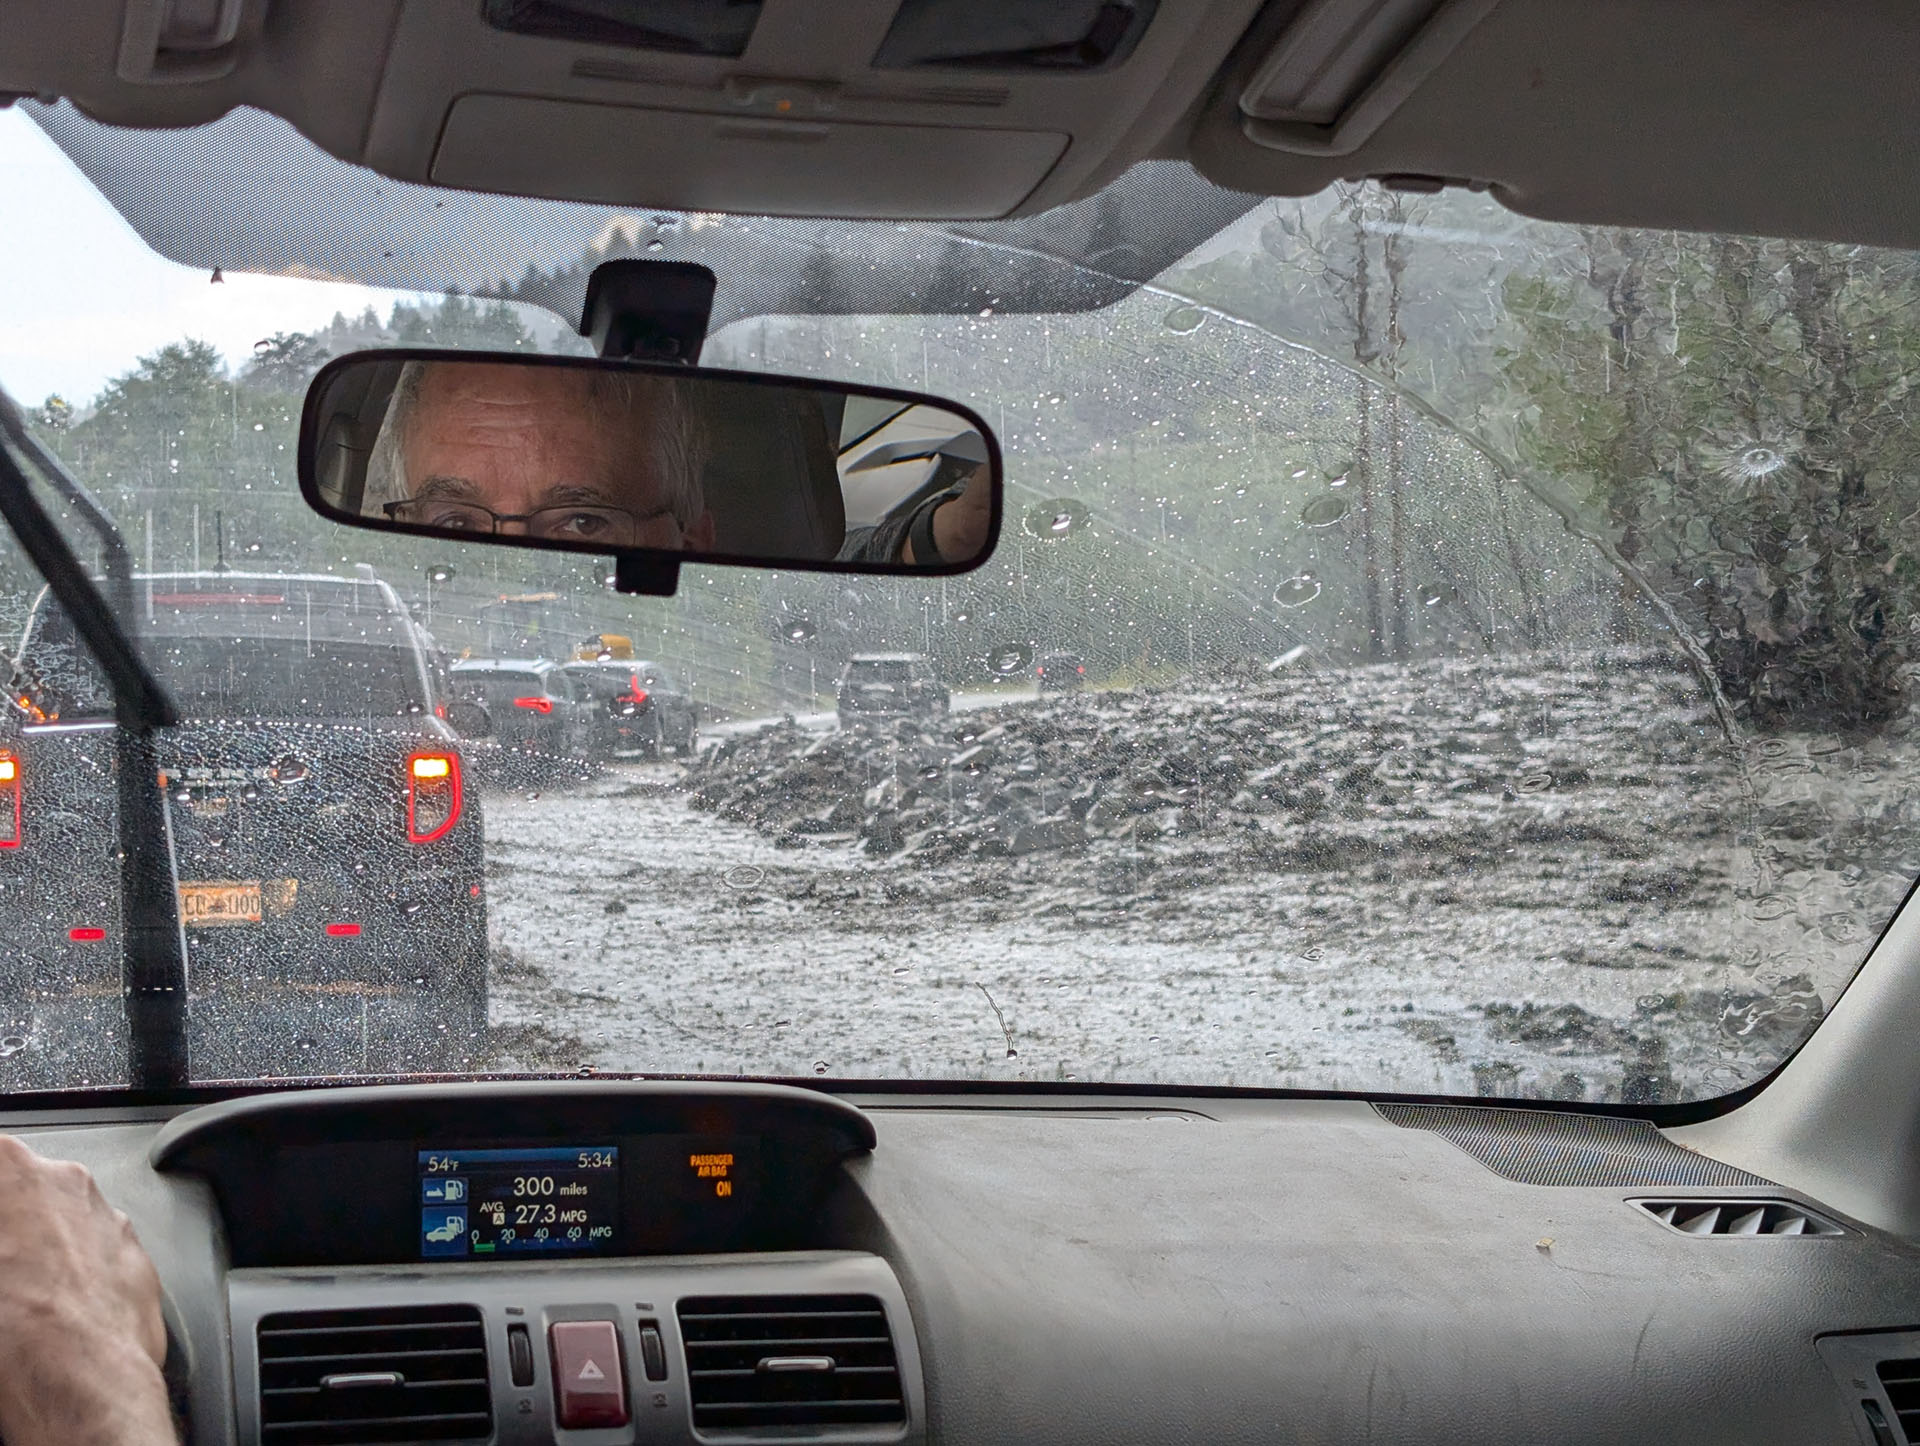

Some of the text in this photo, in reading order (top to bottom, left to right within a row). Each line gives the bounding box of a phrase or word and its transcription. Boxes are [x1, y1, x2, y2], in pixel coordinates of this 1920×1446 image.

[428, 1156, 459, 1172] 54°F
[577, 1152, 612, 1168] 5:34
[690, 1153, 733, 1167] PASSENGER
[513, 1177, 588, 1196] 300 miles
[716, 1181, 731, 1196] ON
[479, 1201, 506, 1213] AVG.
[515, 1204, 588, 1225] 27.3 MPG
[471, 1226, 612, 1241] 0 20 40 60 MPG
